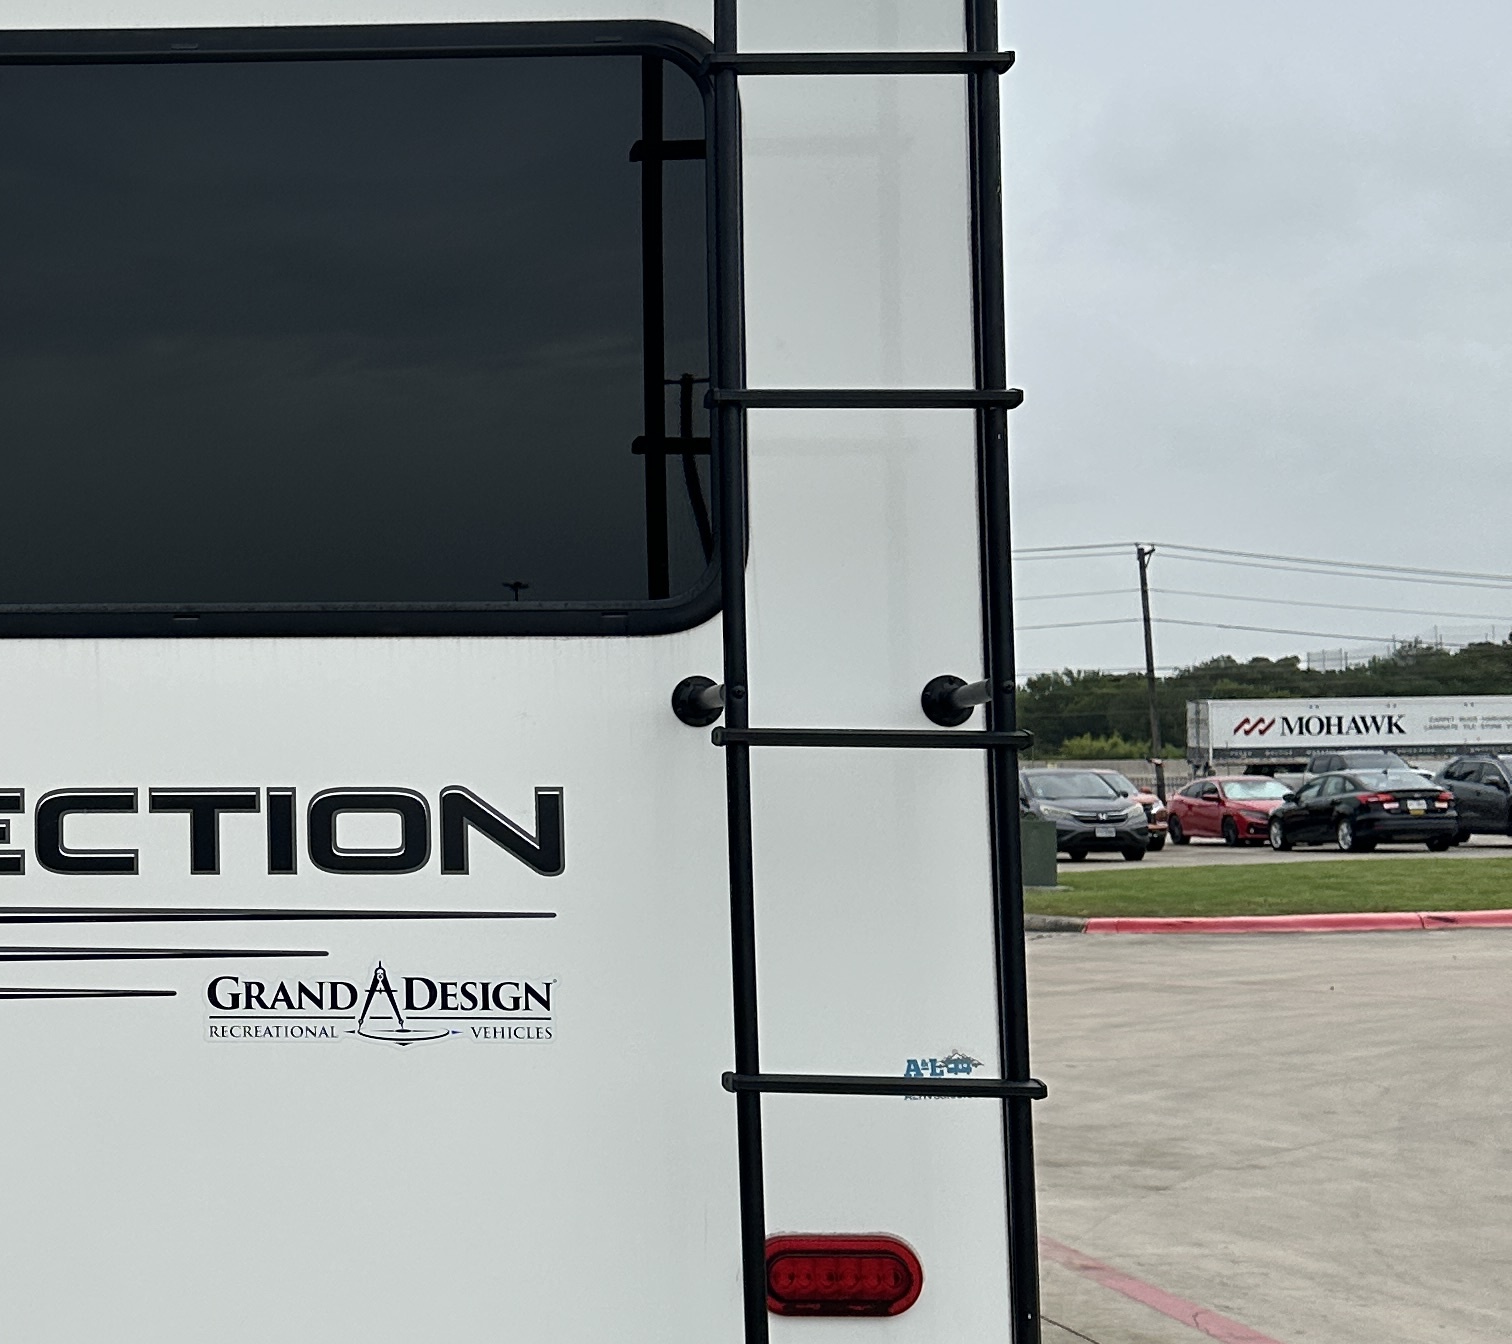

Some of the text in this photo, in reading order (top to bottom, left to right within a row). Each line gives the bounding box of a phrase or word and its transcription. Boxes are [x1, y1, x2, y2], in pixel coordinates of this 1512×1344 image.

[1280, 713, 1406, 736] MOHAWK
[207, 975, 554, 1012] GRAND DESIGN
[208, 1025, 554, 1040] RECREATIONAL VEHICLES
